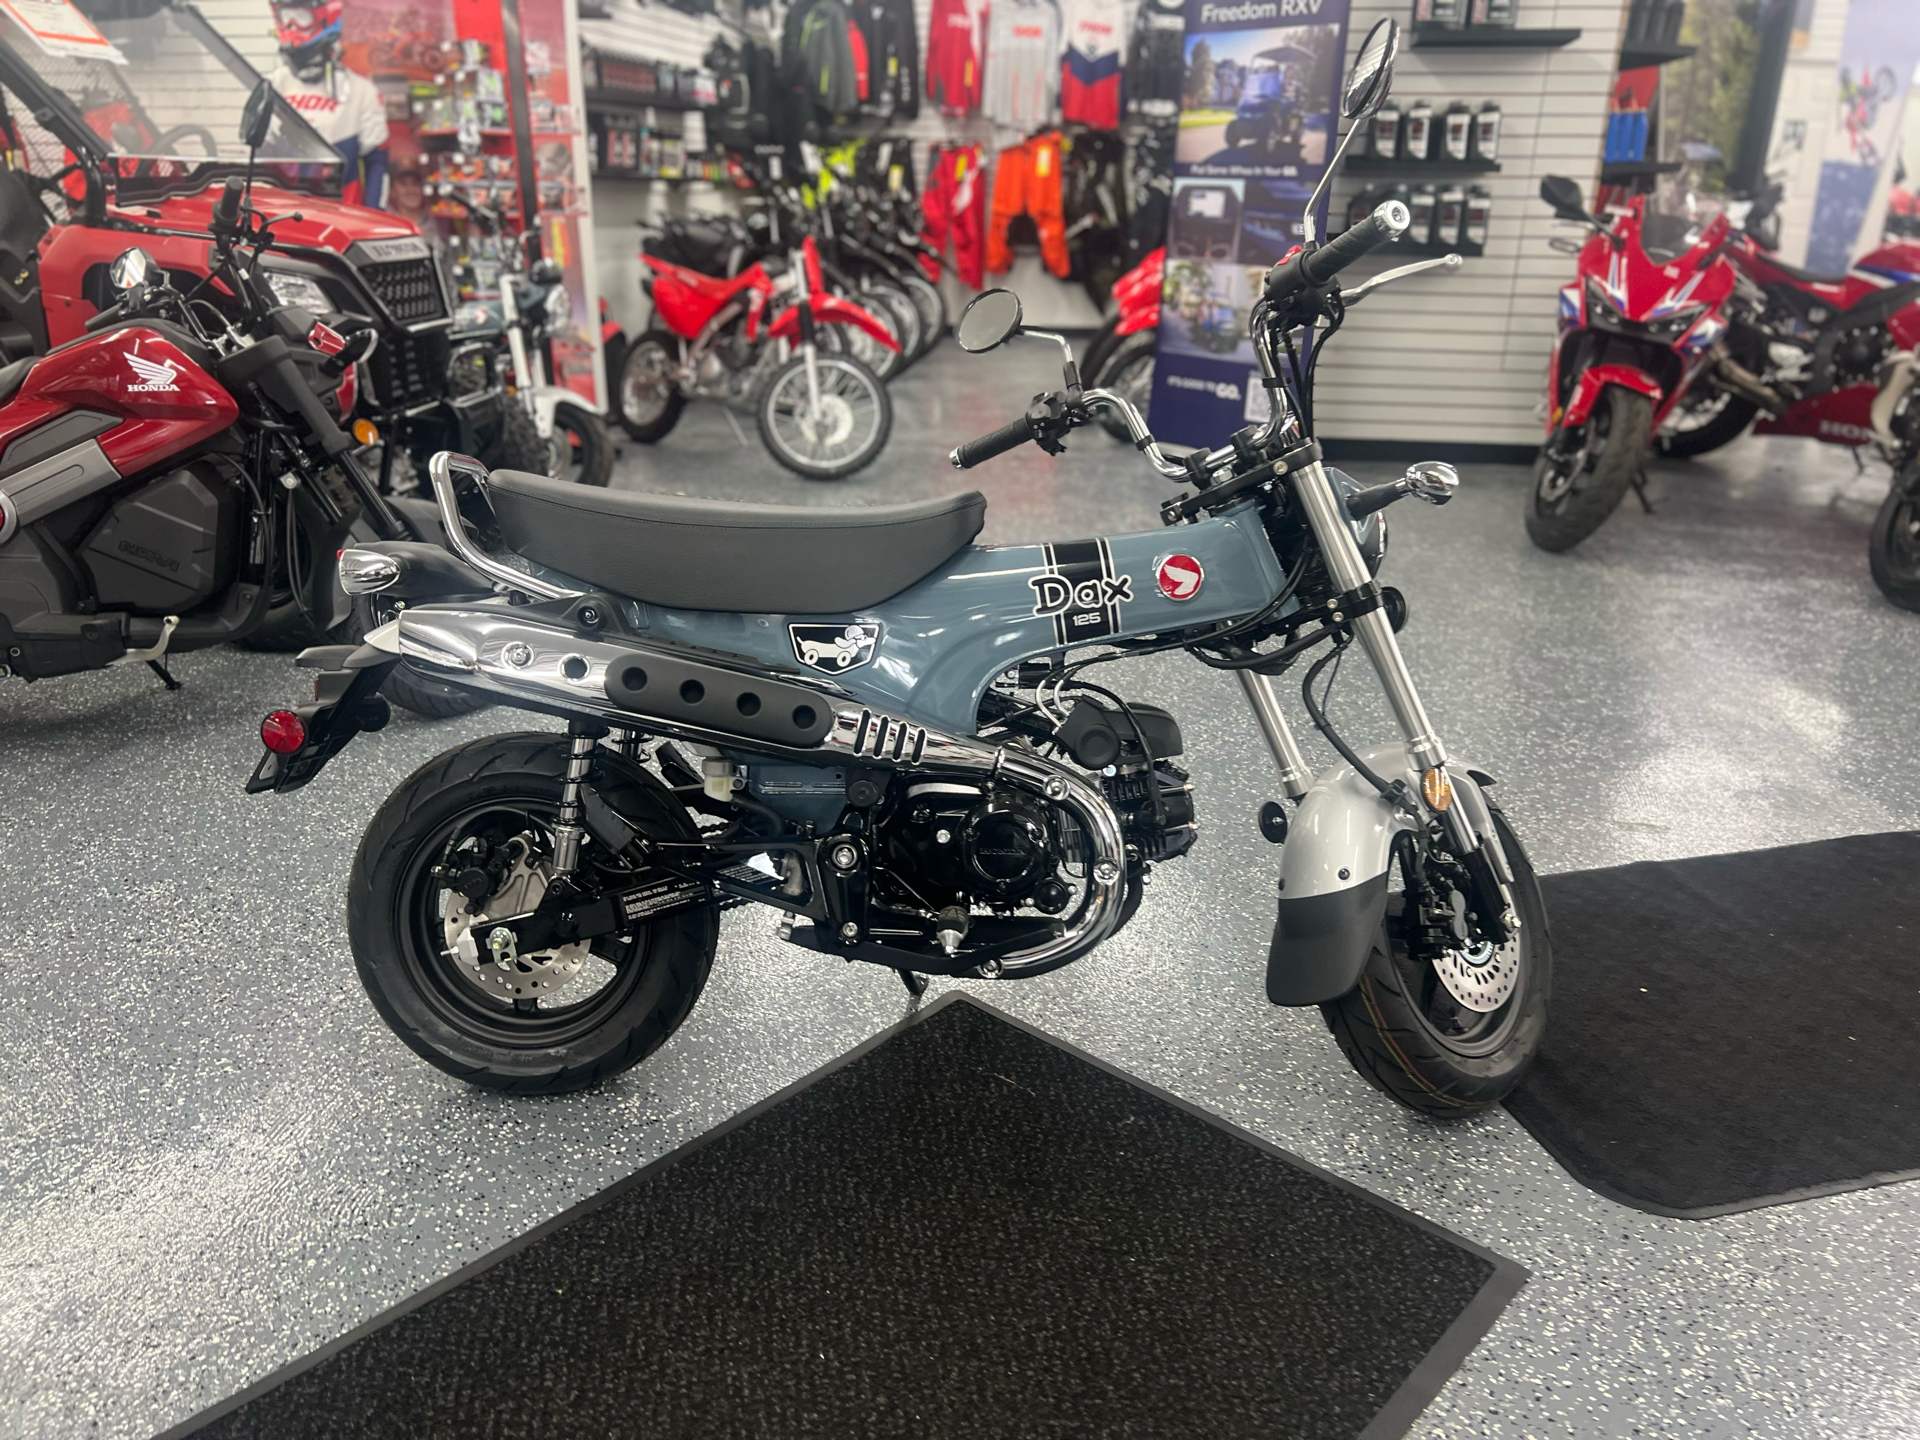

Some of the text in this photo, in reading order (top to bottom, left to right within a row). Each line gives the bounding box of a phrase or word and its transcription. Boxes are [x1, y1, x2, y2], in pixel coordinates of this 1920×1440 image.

[1200, 1, 1277, 24] Freedom
[1280, 0, 1323, 17] RXV
[127, 384, 181, 392] HONDA
[1028, 575, 1134, 616] Dax
[1072, 612, 1101, 627] 125
